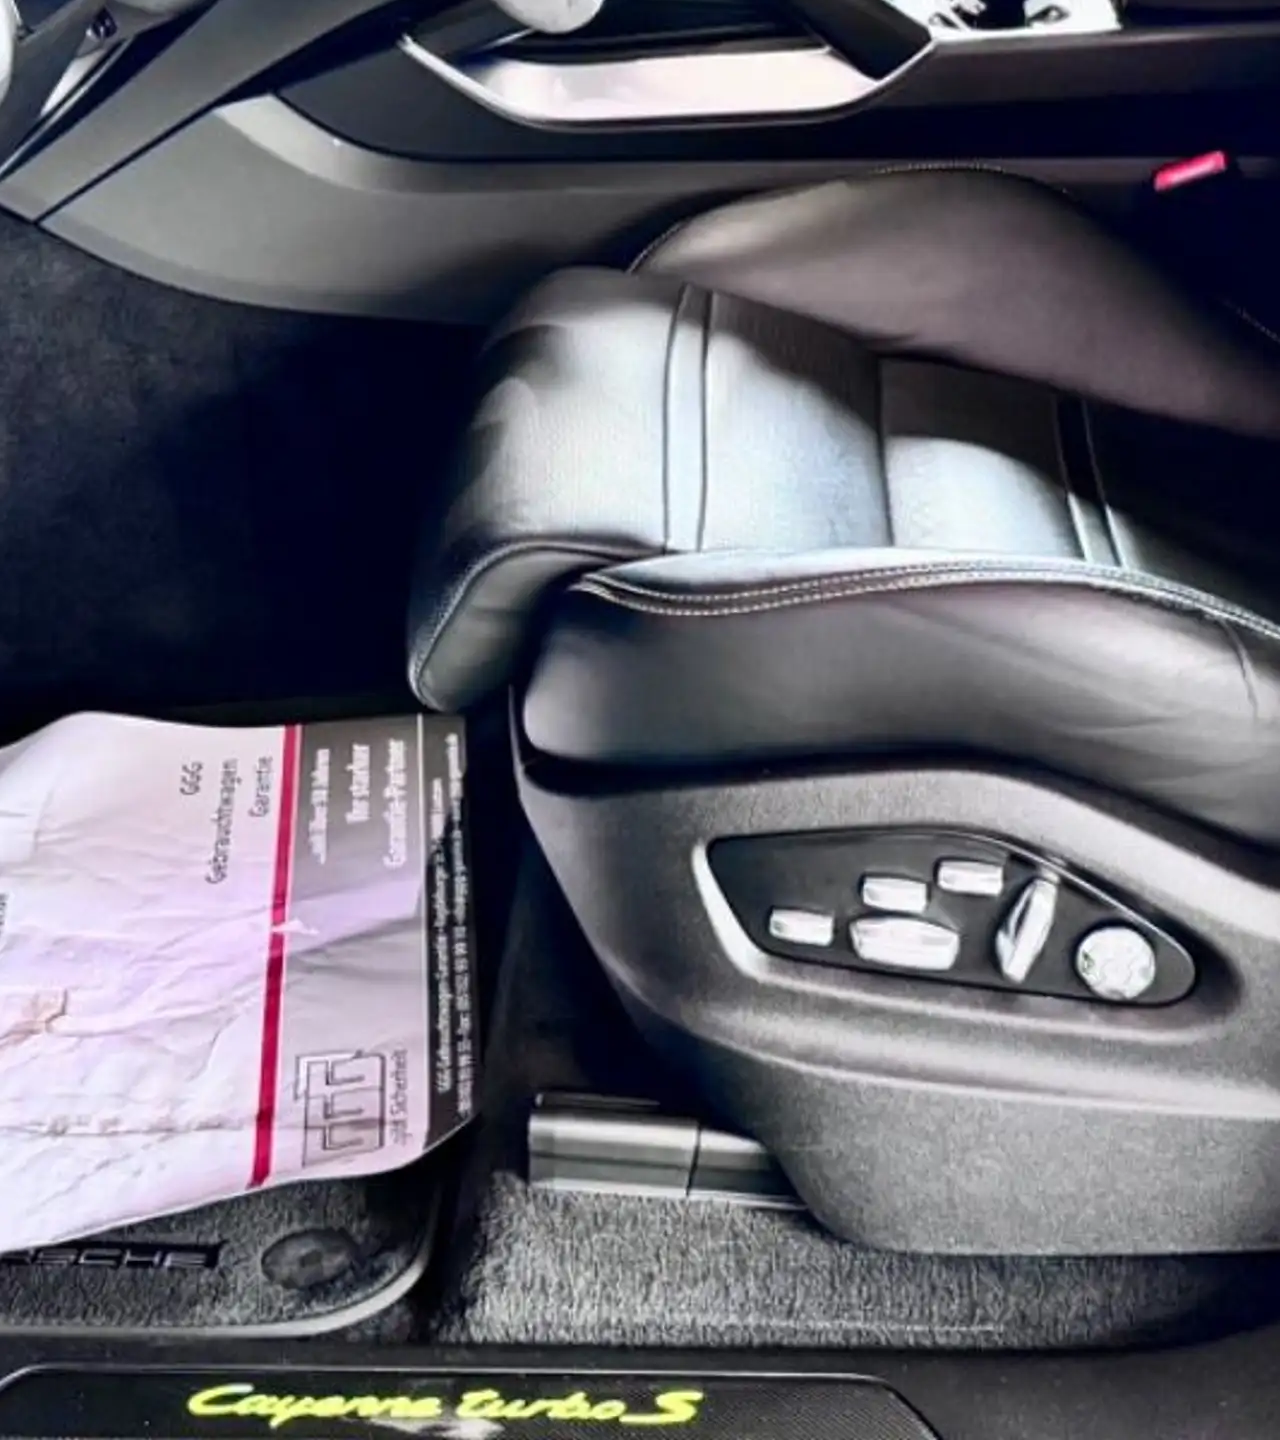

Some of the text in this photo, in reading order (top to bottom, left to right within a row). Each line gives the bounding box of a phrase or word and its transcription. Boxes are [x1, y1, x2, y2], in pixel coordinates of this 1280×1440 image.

[180, 761, 203, 796] GGG
[248, 756, 273, 818] Garantie
[205, 759, 242, 885] Gebrauchtwagen
[187, 1383, 704, 1428] Cayenne turbo S
